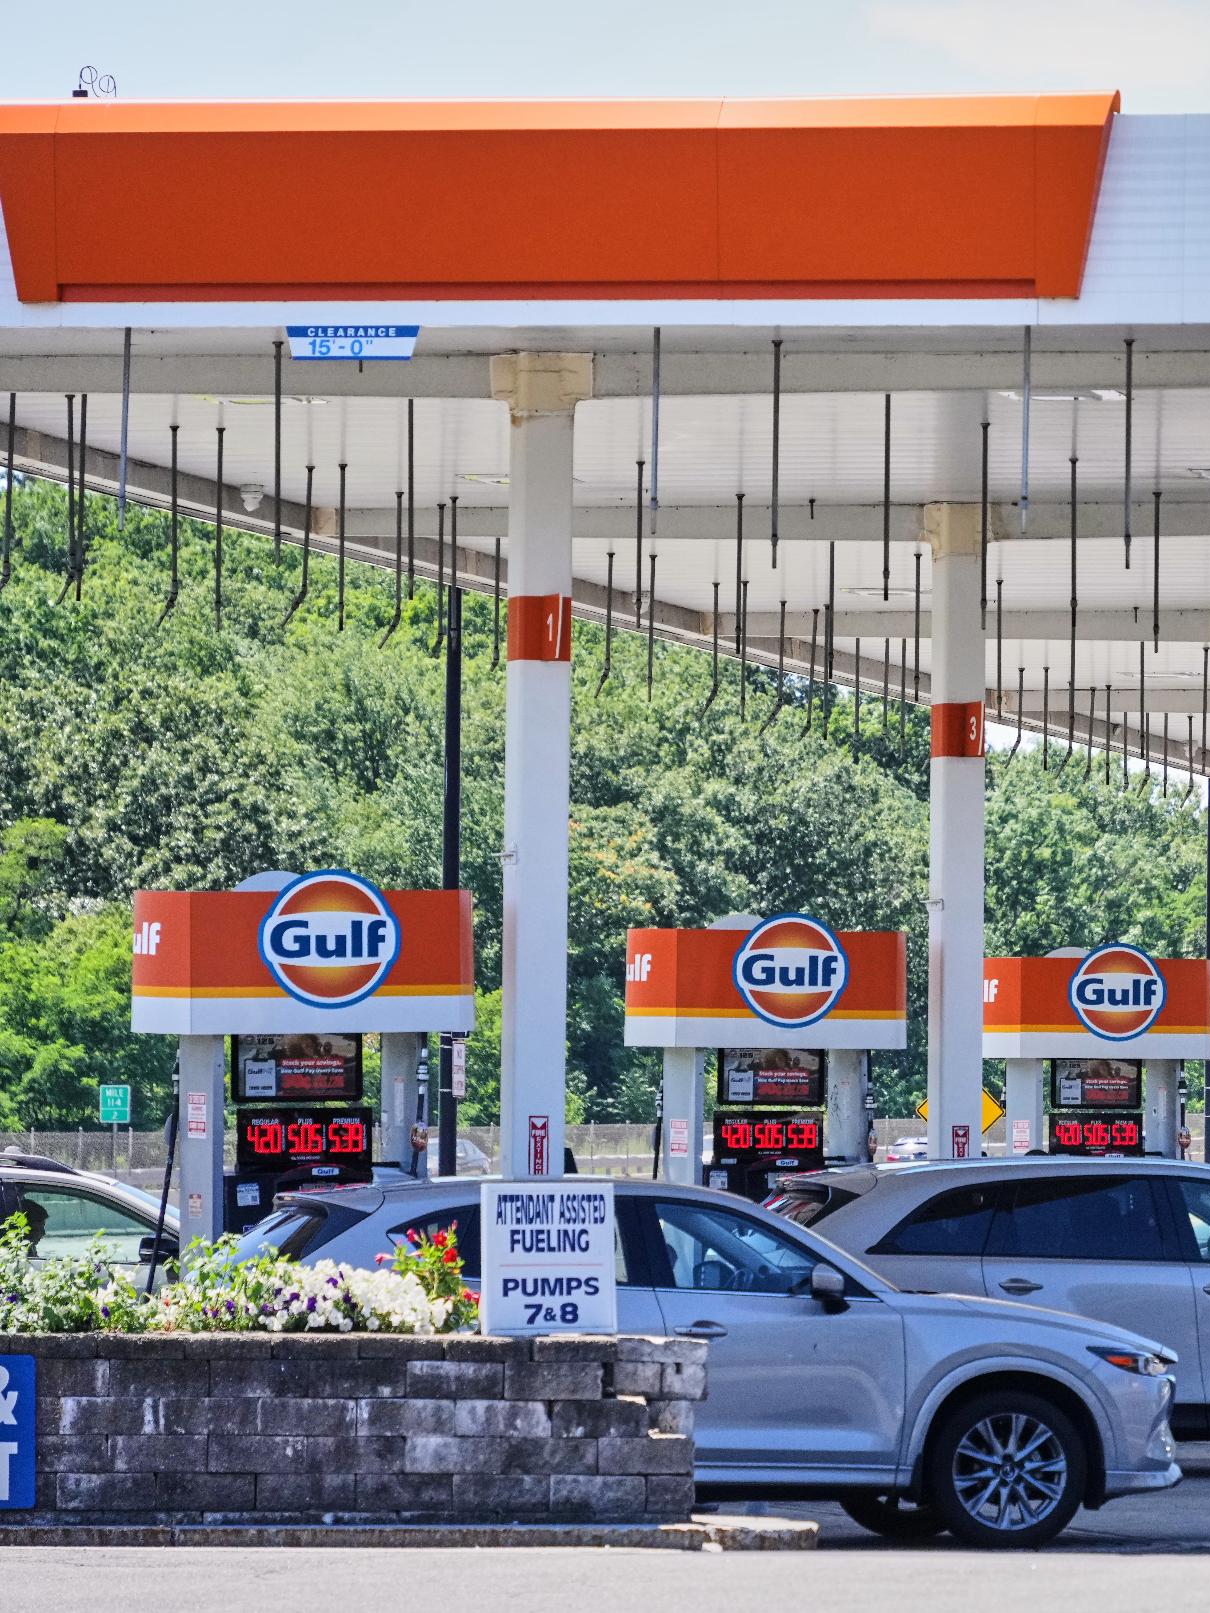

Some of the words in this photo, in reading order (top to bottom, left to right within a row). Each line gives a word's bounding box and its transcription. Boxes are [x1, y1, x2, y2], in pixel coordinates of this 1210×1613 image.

[307, 327, 397, 337] CLEARANCE
[546, 612, 553, 641] 1
[969, 716, 977, 741] 3
[132, 921, 161, 956] ulf
[270, 919, 388, 959] Gulf
[625, 953, 652, 982] ulf
[741, 953, 839, 988] Gulf
[1075, 977, 1158, 1007] Gulf
[105, 1088, 123, 1098] MILE
[112, 1111, 118, 1119] 2
[496, 1194, 555, 1225] ATTENDANT
[558, 1194, 606, 1225] ASSISTED
[509, 1229, 590, 1253] FUELING
[502, 1276, 600, 1297] PUMPS
[523, 1302, 579, 1326] 7&8
